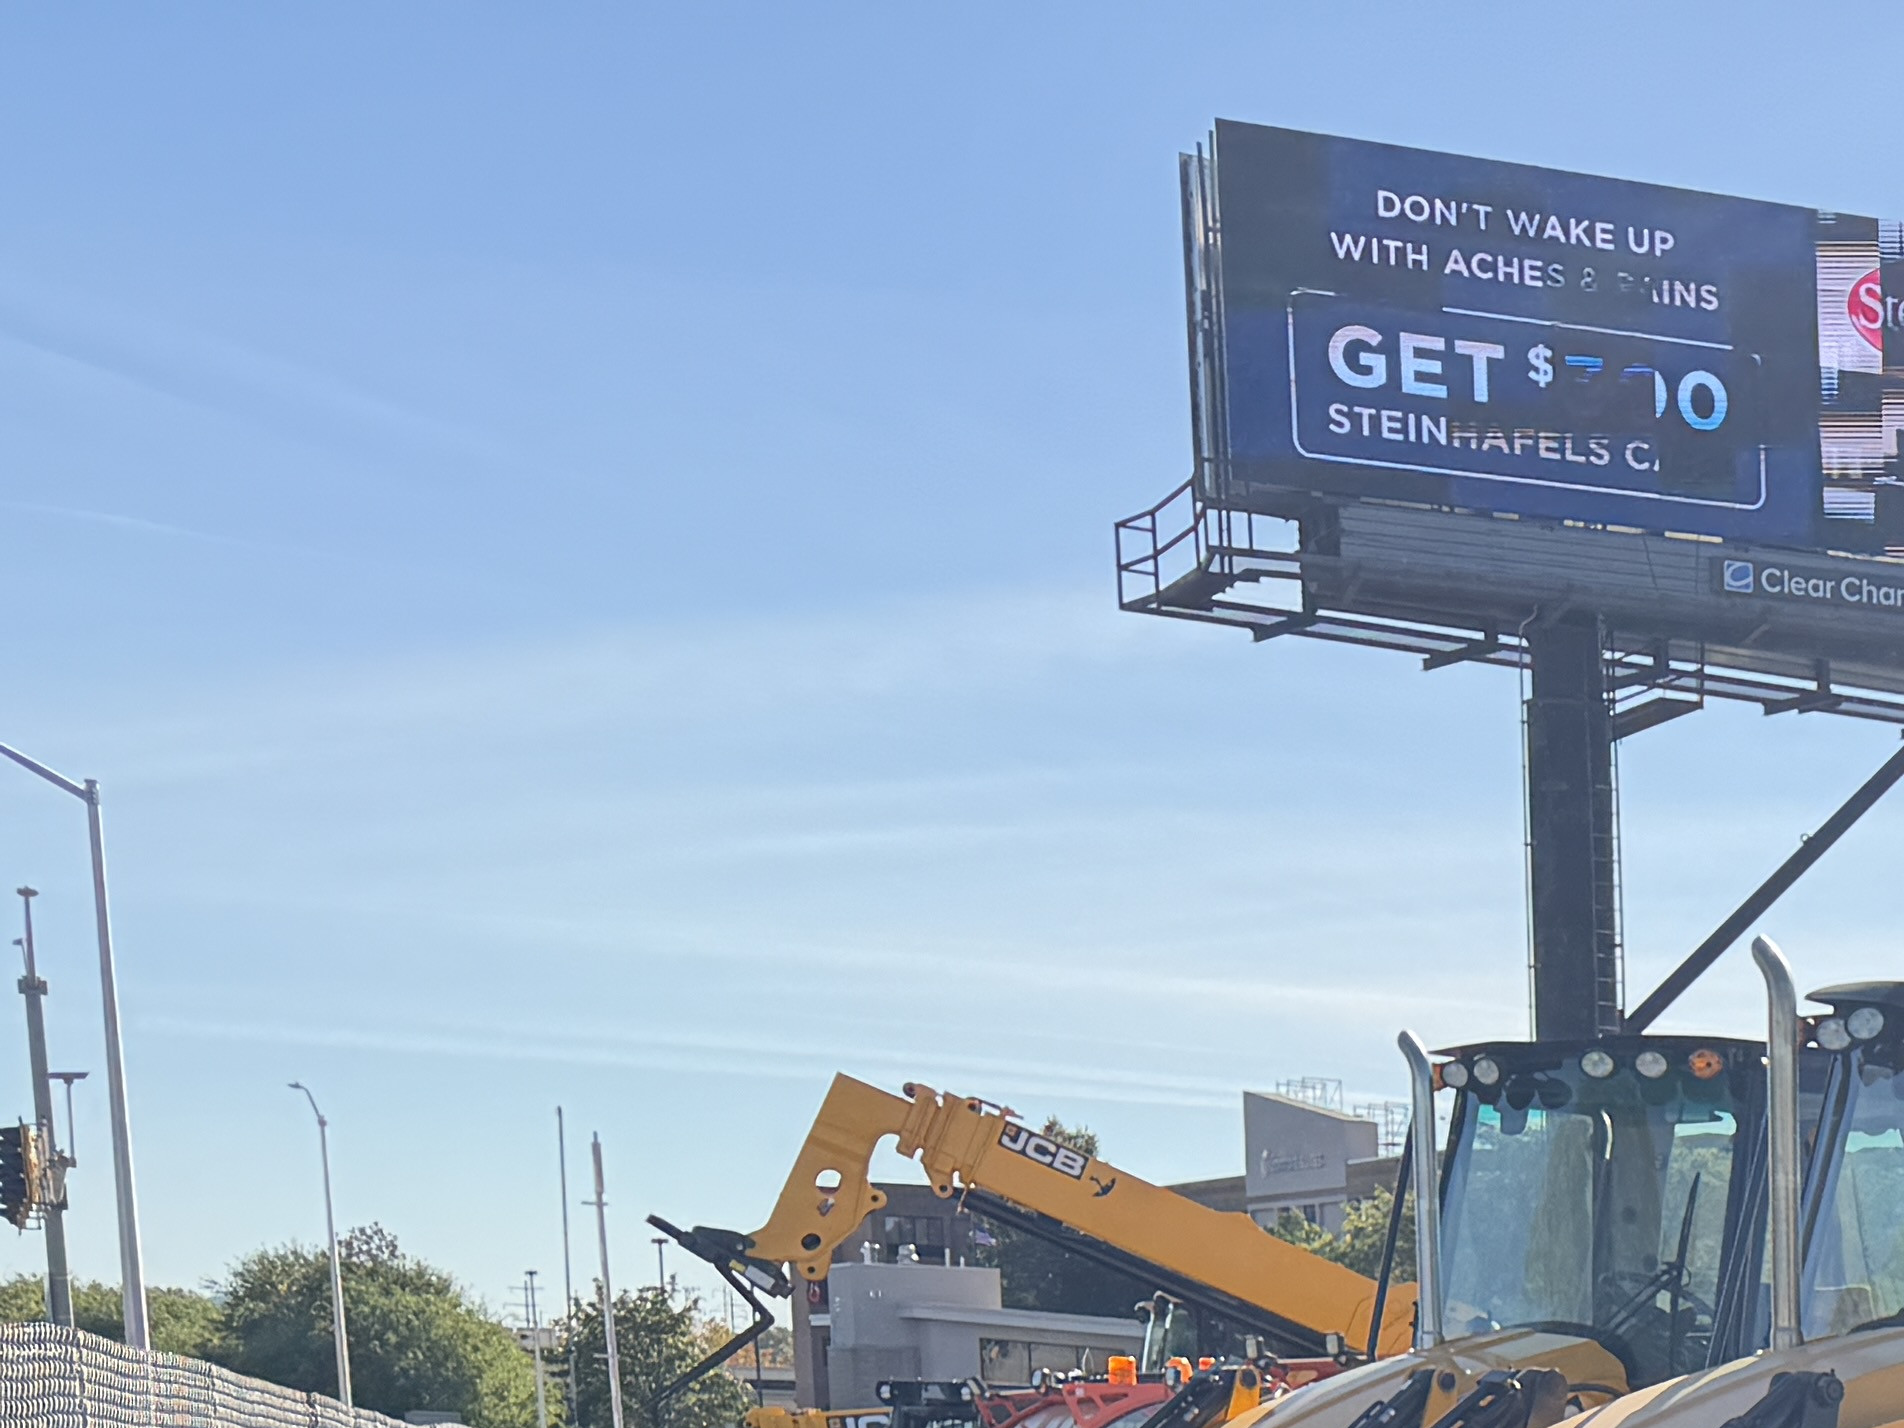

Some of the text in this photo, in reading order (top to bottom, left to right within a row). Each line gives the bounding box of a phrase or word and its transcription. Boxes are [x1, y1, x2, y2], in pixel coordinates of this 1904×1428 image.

[1376, 189, 1676, 257] DON'T WAKE UP
[1330, 231, 1429, 271] WITH
[1443, 249, 1565, 288] ACHES
[1328, 324, 1505, 403] GET
[1760, 567, 1836, 600] Clear
[1001, 1130, 1085, 1177] JCB
